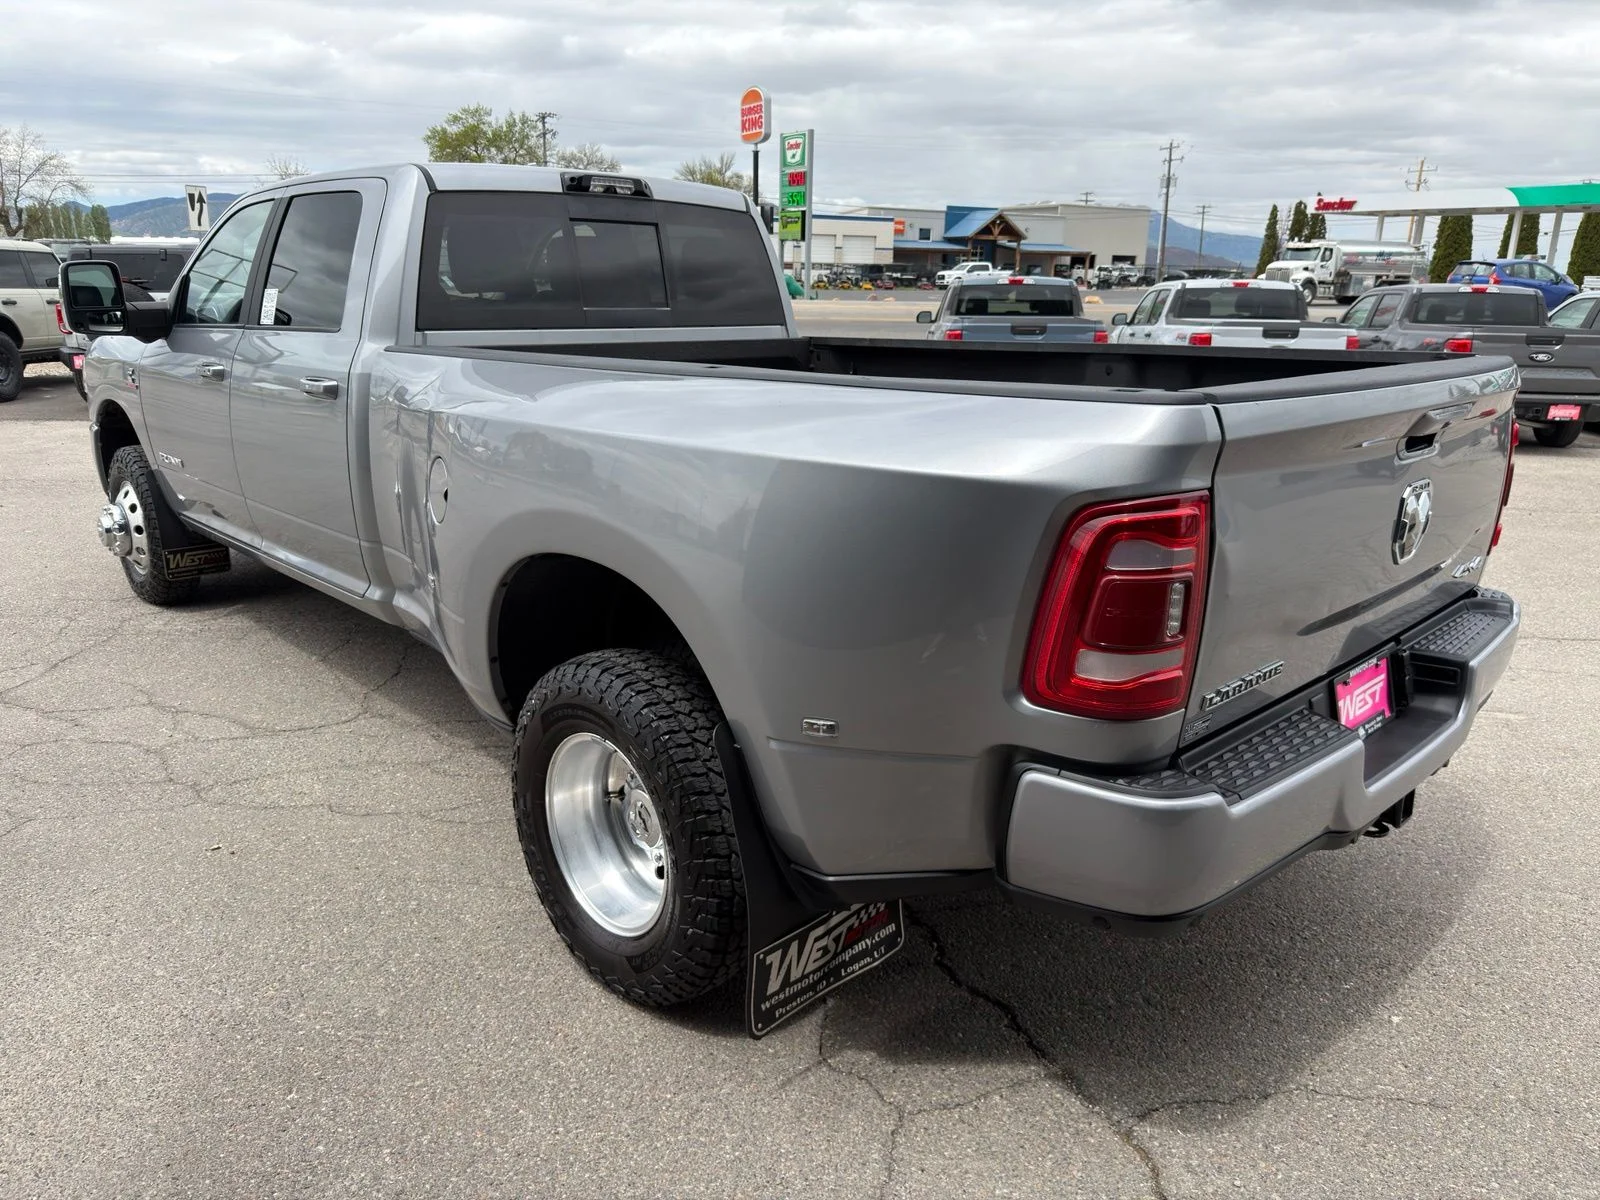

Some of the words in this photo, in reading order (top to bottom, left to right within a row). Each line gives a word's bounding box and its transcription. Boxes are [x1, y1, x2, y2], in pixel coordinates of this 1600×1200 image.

[741, 103, 763, 118] BURGER
[741, 114, 763, 133] KING
[1314, 197, 1357, 211] Sinclair
[1411, 481, 1430, 494] RAM
[166, 551, 208, 569] WEST
[1200, 660, 1284, 710] LARAMIE
[1338, 673, 1386, 725] WEST
[765, 902, 861, 996] WEST
[873, 944, 887, 959] UT
[760, 922, 897, 1012] westmotorcompany.com
